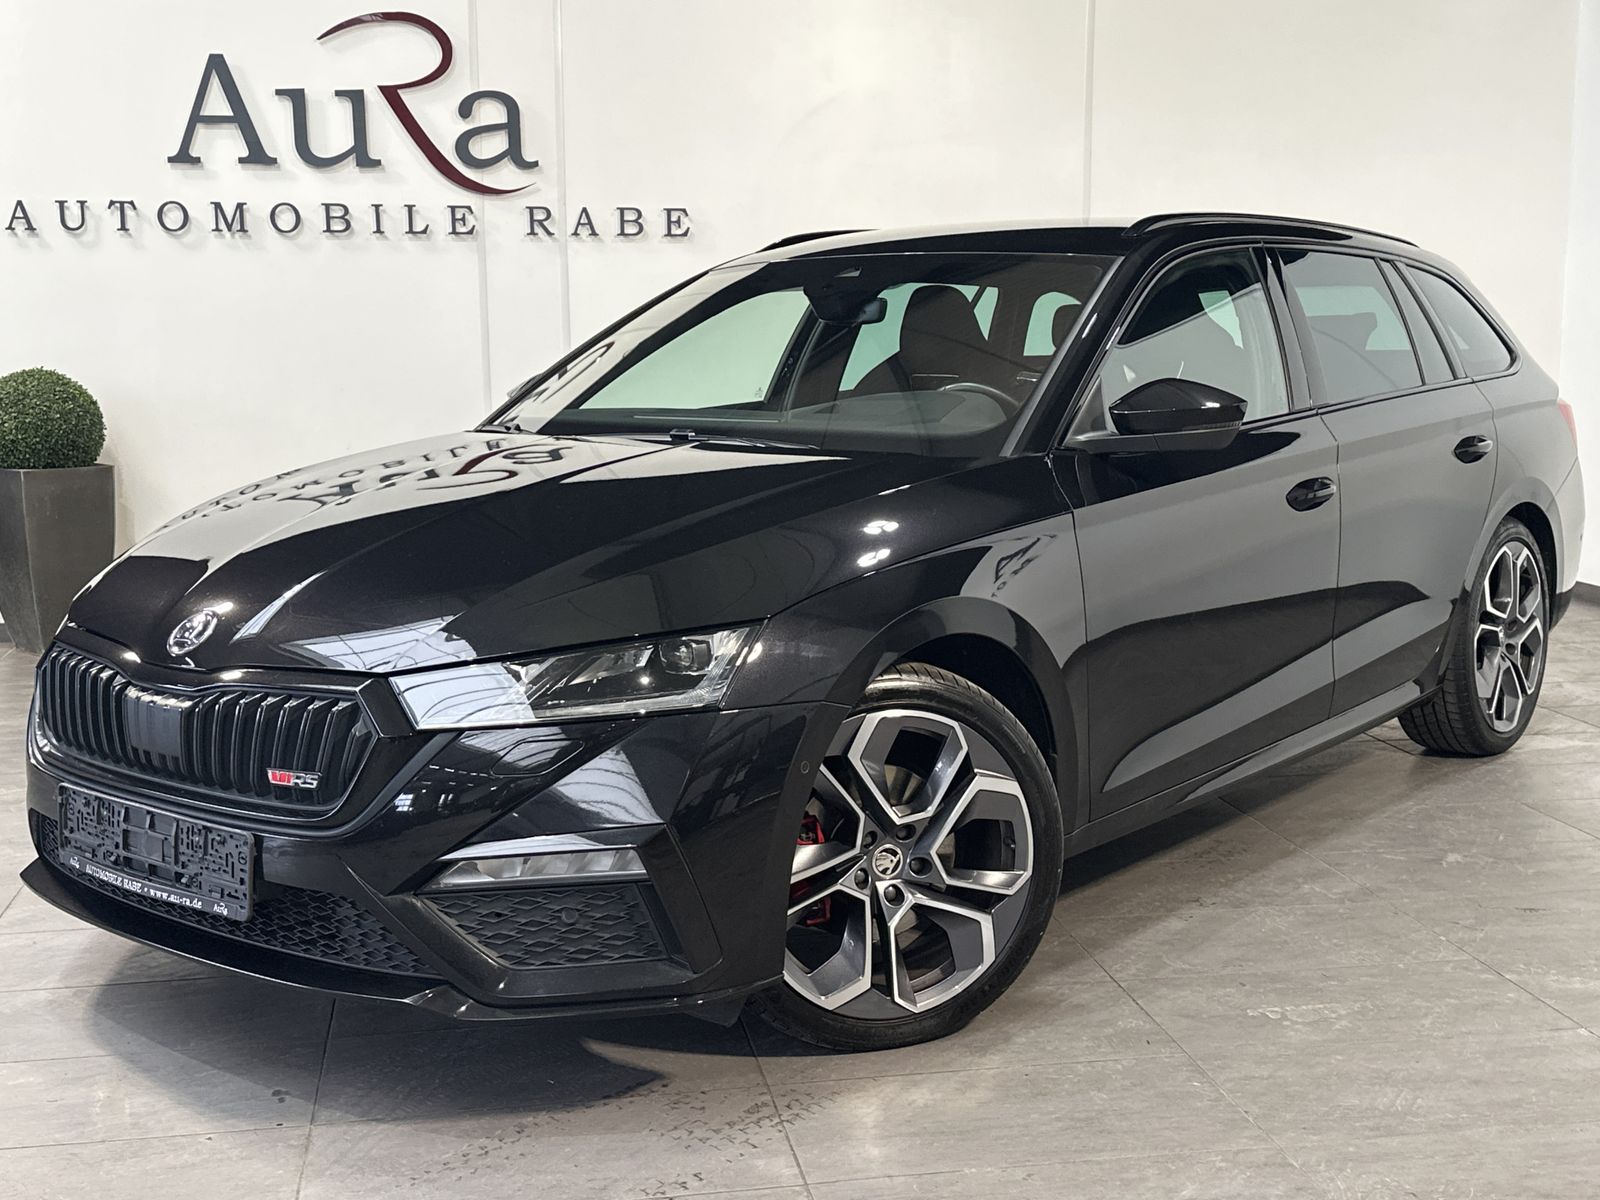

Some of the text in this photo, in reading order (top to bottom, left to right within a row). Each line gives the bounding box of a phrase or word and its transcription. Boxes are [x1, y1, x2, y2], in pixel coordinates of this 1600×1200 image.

[5, 199, 692, 238] AUTOMOBILE RABE
[85, 863, 123, 887] AUTOMOBILE
[123, 878, 143, 893] RABE
[149, 888, 203, 909] www.au-ra.de
